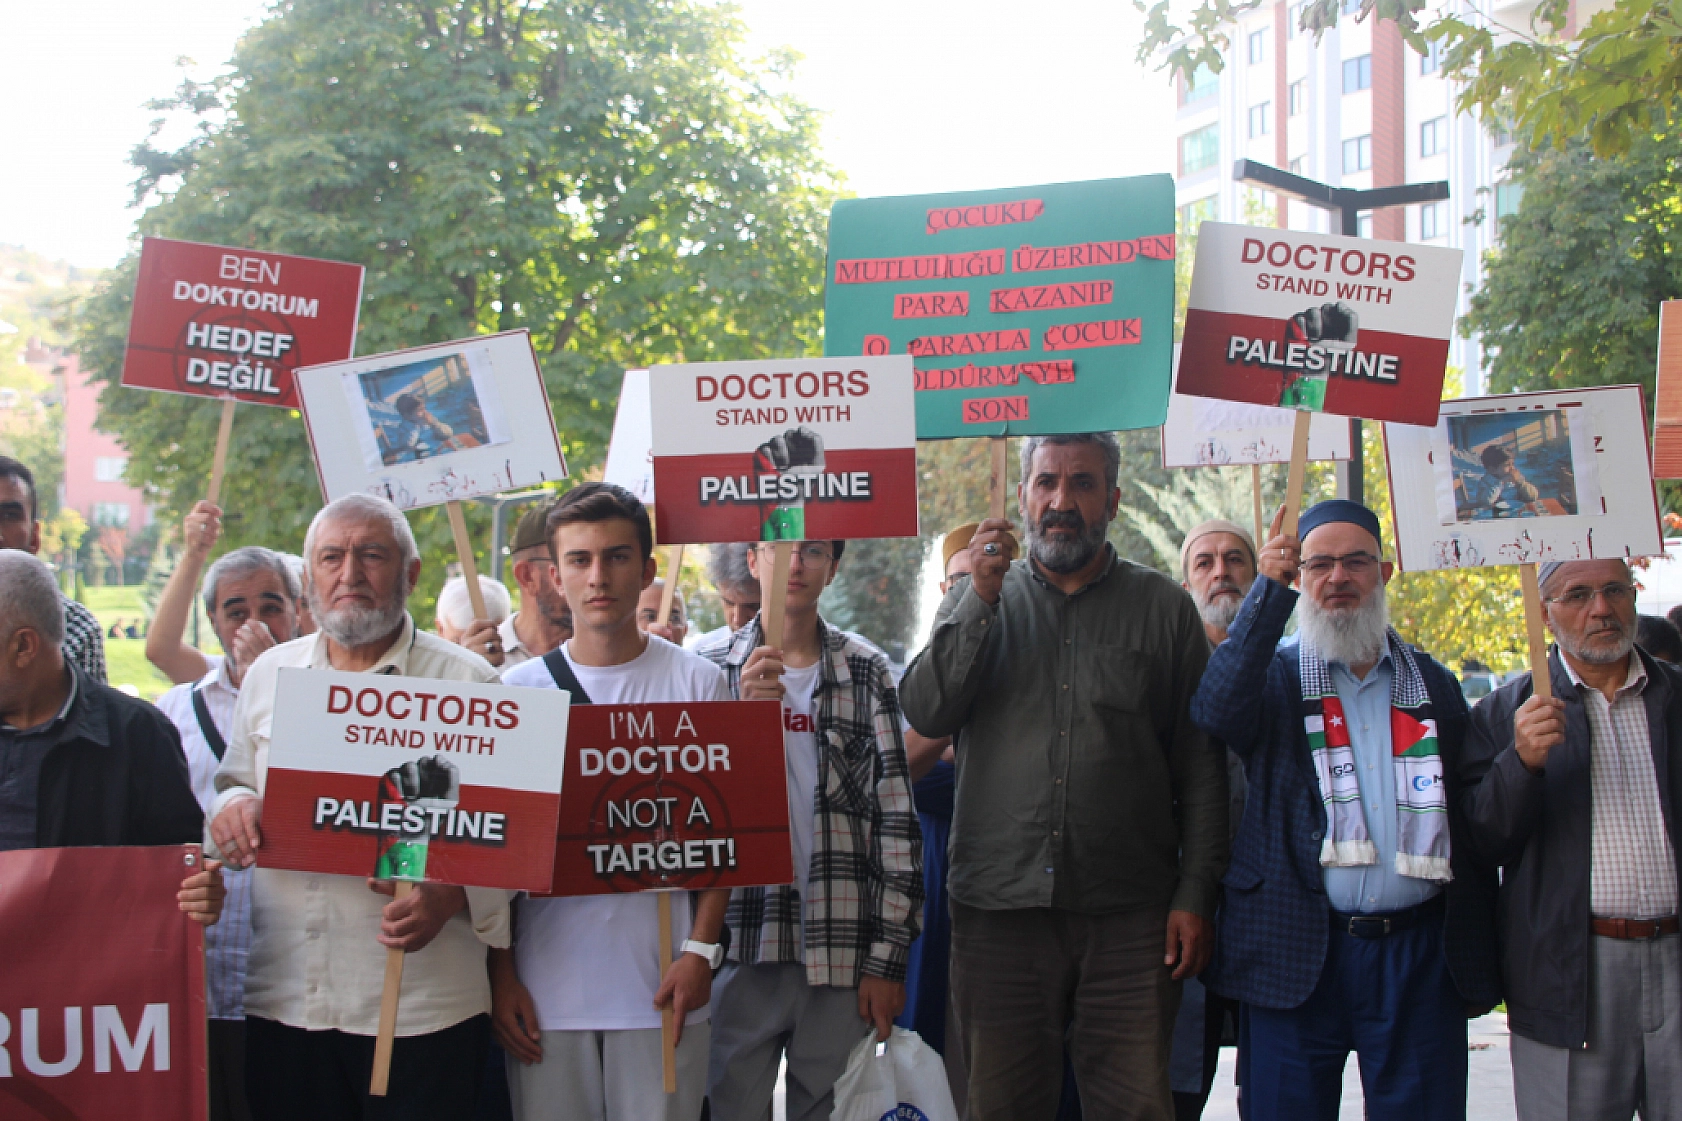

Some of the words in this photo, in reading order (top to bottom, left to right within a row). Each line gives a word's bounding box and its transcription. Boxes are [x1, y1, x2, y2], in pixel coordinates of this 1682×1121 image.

[219, 254, 281, 285] BEN
[1015, 236, 1173, 270] ÜZERİNDEN
[1241, 238, 1416, 282] DOCTORS
[173, 280, 318, 318] DOKTORUM
[900, 295, 965, 315] PARA
[994, 282, 1113, 311] KAZANIP
[1256, 273, 1329, 298] STAND
[1336, 281, 1393, 305] WITH
[186, 322, 294, 357] HEDEF
[868, 338, 886, 356] O
[911, 330, 1028, 356] PARAYLA
[1044, 318, 1139, 351] ÇOCUK
[186, 354, 281, 394] DEĞİL
[1227, 335, 1399, 380] PALESTINE
[695, 369, 870, 402] DOCTORS
[715, 407, 788, 426] STAND
[793, 404, 851, 423] WITH
[968, 398, 1029, 422] SON!
[701, 471, 871, 502] PALESTINE
[327, 685, 520, 730] DOCTORS
[344, 724, 426, 749] STAND
[432, 731, 495, 756] WITH
[609, 711, 655, 740] I'M
[675, 710, 697, 738] A
[579, 743, 731, 776] DOCTOR
[315, 798, 506, 841] PALESTINE
[608, 798, 677, 828] NOT
[687, 795, 710, 824] A
[587, 838, 736, 874] TARGET!
[0, 1002, 171, 1078] UM
